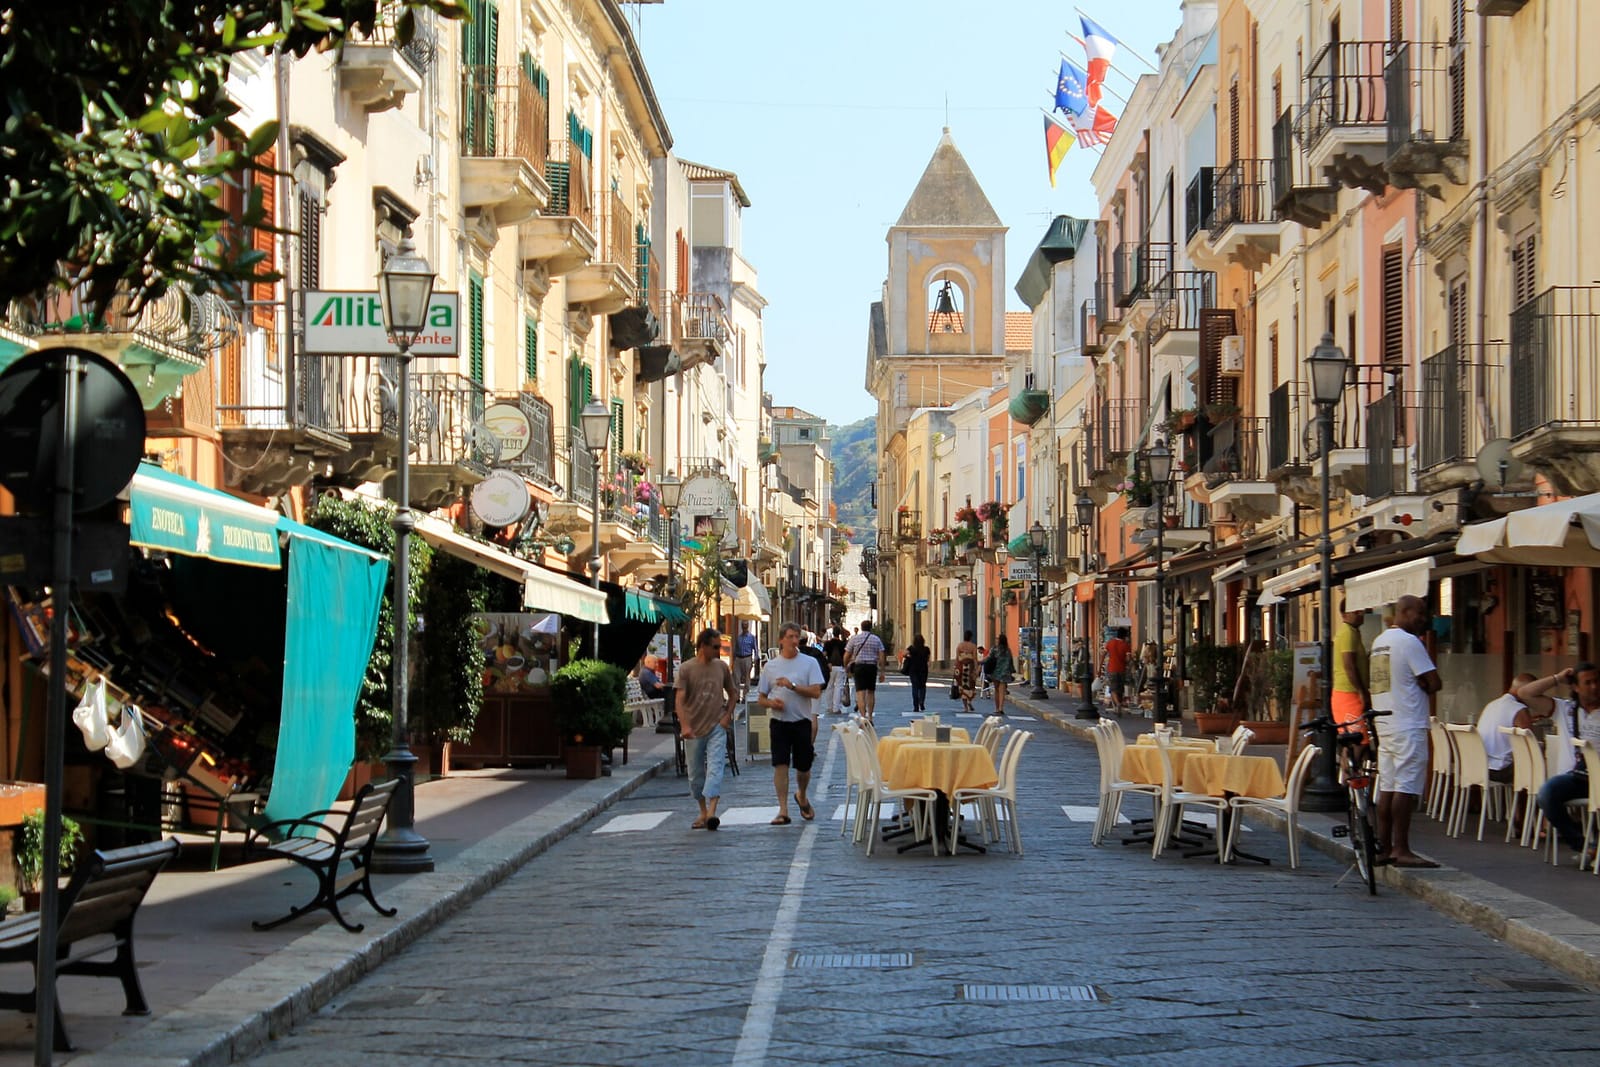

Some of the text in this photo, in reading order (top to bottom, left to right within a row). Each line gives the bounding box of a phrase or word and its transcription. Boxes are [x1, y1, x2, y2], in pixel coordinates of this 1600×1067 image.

[310, 297, 452, 327] Alita
[152, 507, 184, 536] ENOTECA
[223, 525, 254, 551] PRODOTTI
